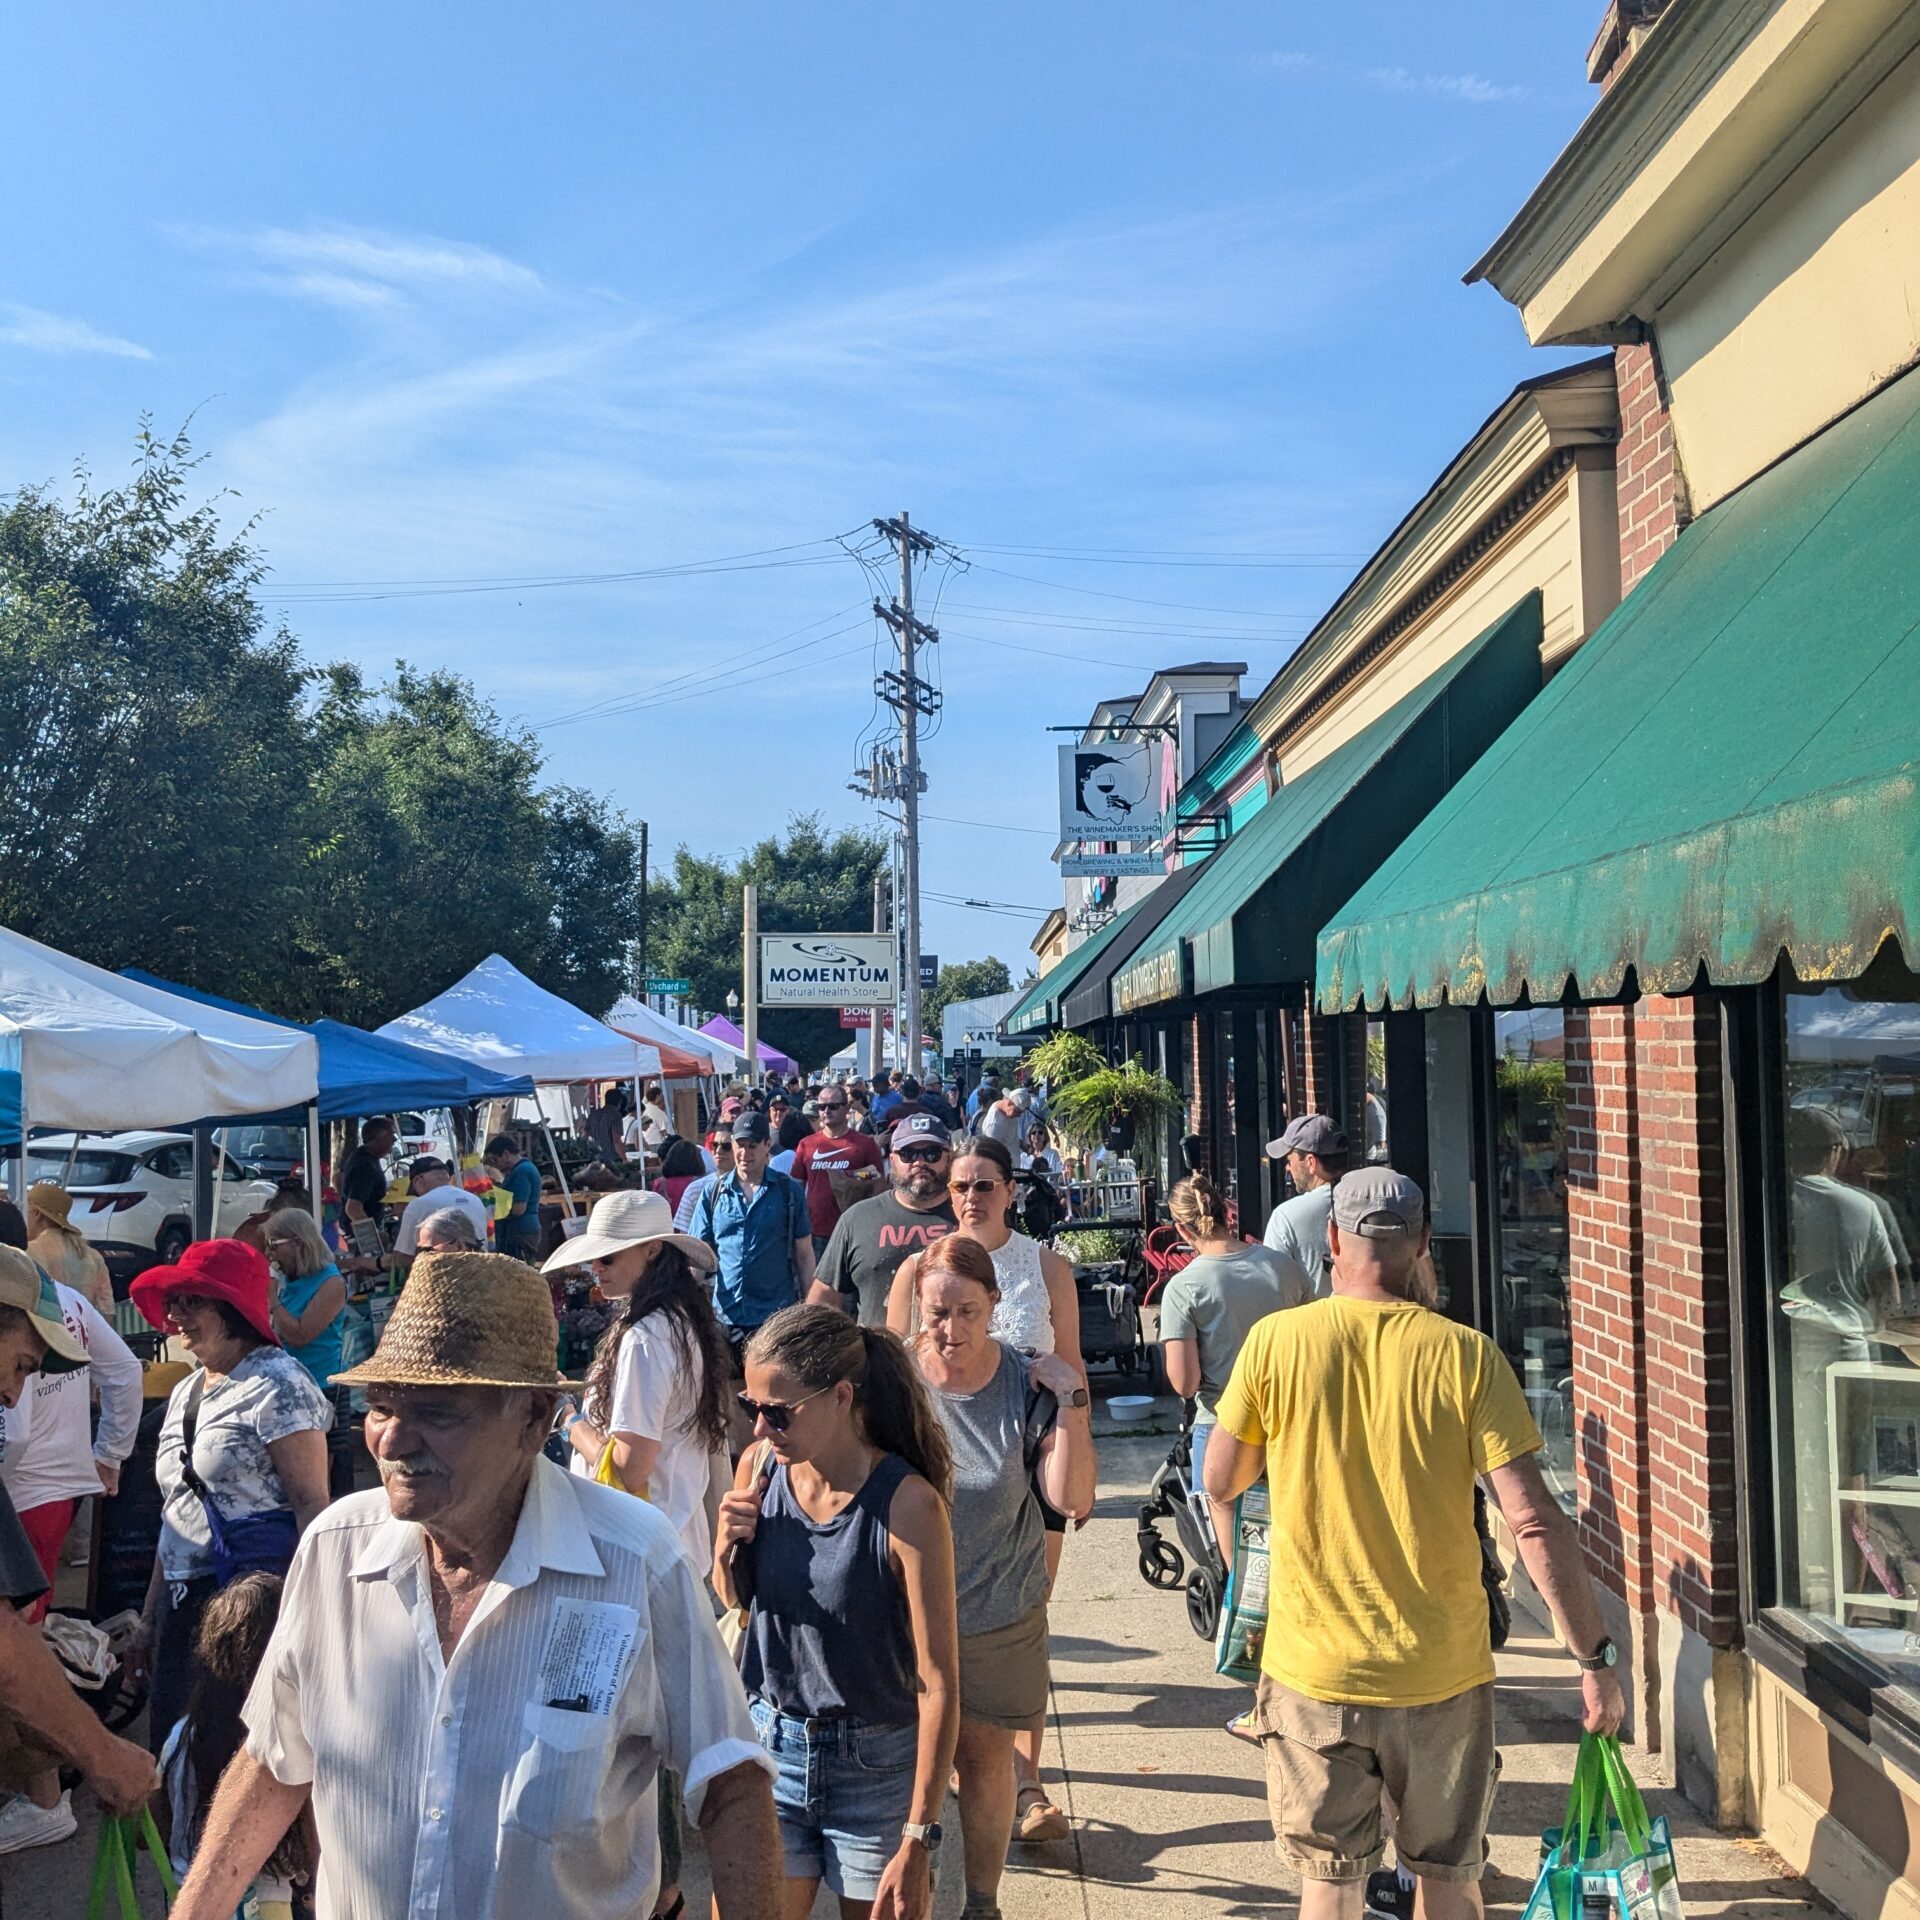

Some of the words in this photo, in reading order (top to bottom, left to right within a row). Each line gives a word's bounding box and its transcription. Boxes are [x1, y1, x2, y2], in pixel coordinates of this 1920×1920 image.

[770, 968, 888, 982] MOMENTUM
[780, 987, 816, 996] Natural
[818, 986, 850, 996] Health
[853, 987, 878, 996] Store
[811, 1160, 850, 1170] ENGLAND
[879, 1224, 955, 1248] NAS
[612, 1634, 631, 1678] Volunteers
[1377, 1889, 1396, 1904] HOKA
